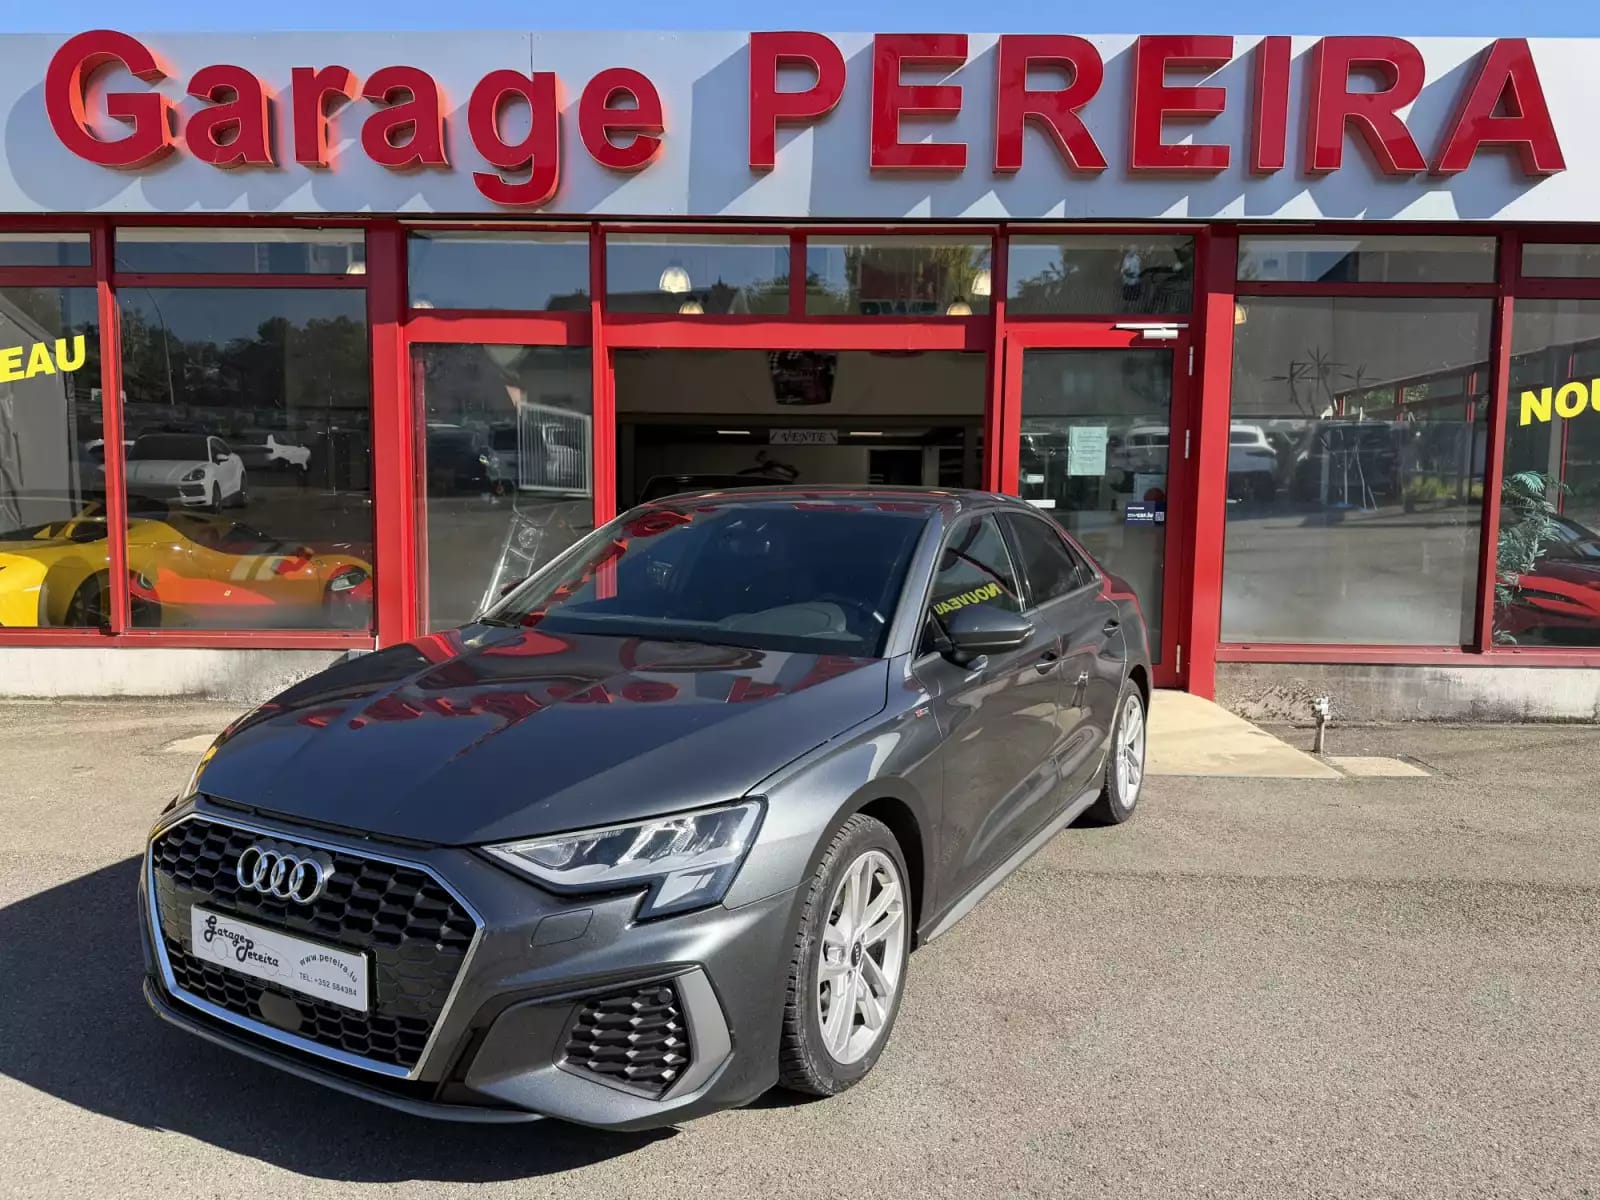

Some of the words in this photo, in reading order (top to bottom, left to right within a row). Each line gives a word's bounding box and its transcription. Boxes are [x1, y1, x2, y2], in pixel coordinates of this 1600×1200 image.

[45, 29, 664, 207] Garage
[749, 31, 1566, 177] PEREIRA
[1519, 378, 1600, 426] NO
[203, 915, 246, 947] Garage
[236, 938, 280, 968] Pereira
[299, 954, 358, 983] www.pereira.lu
